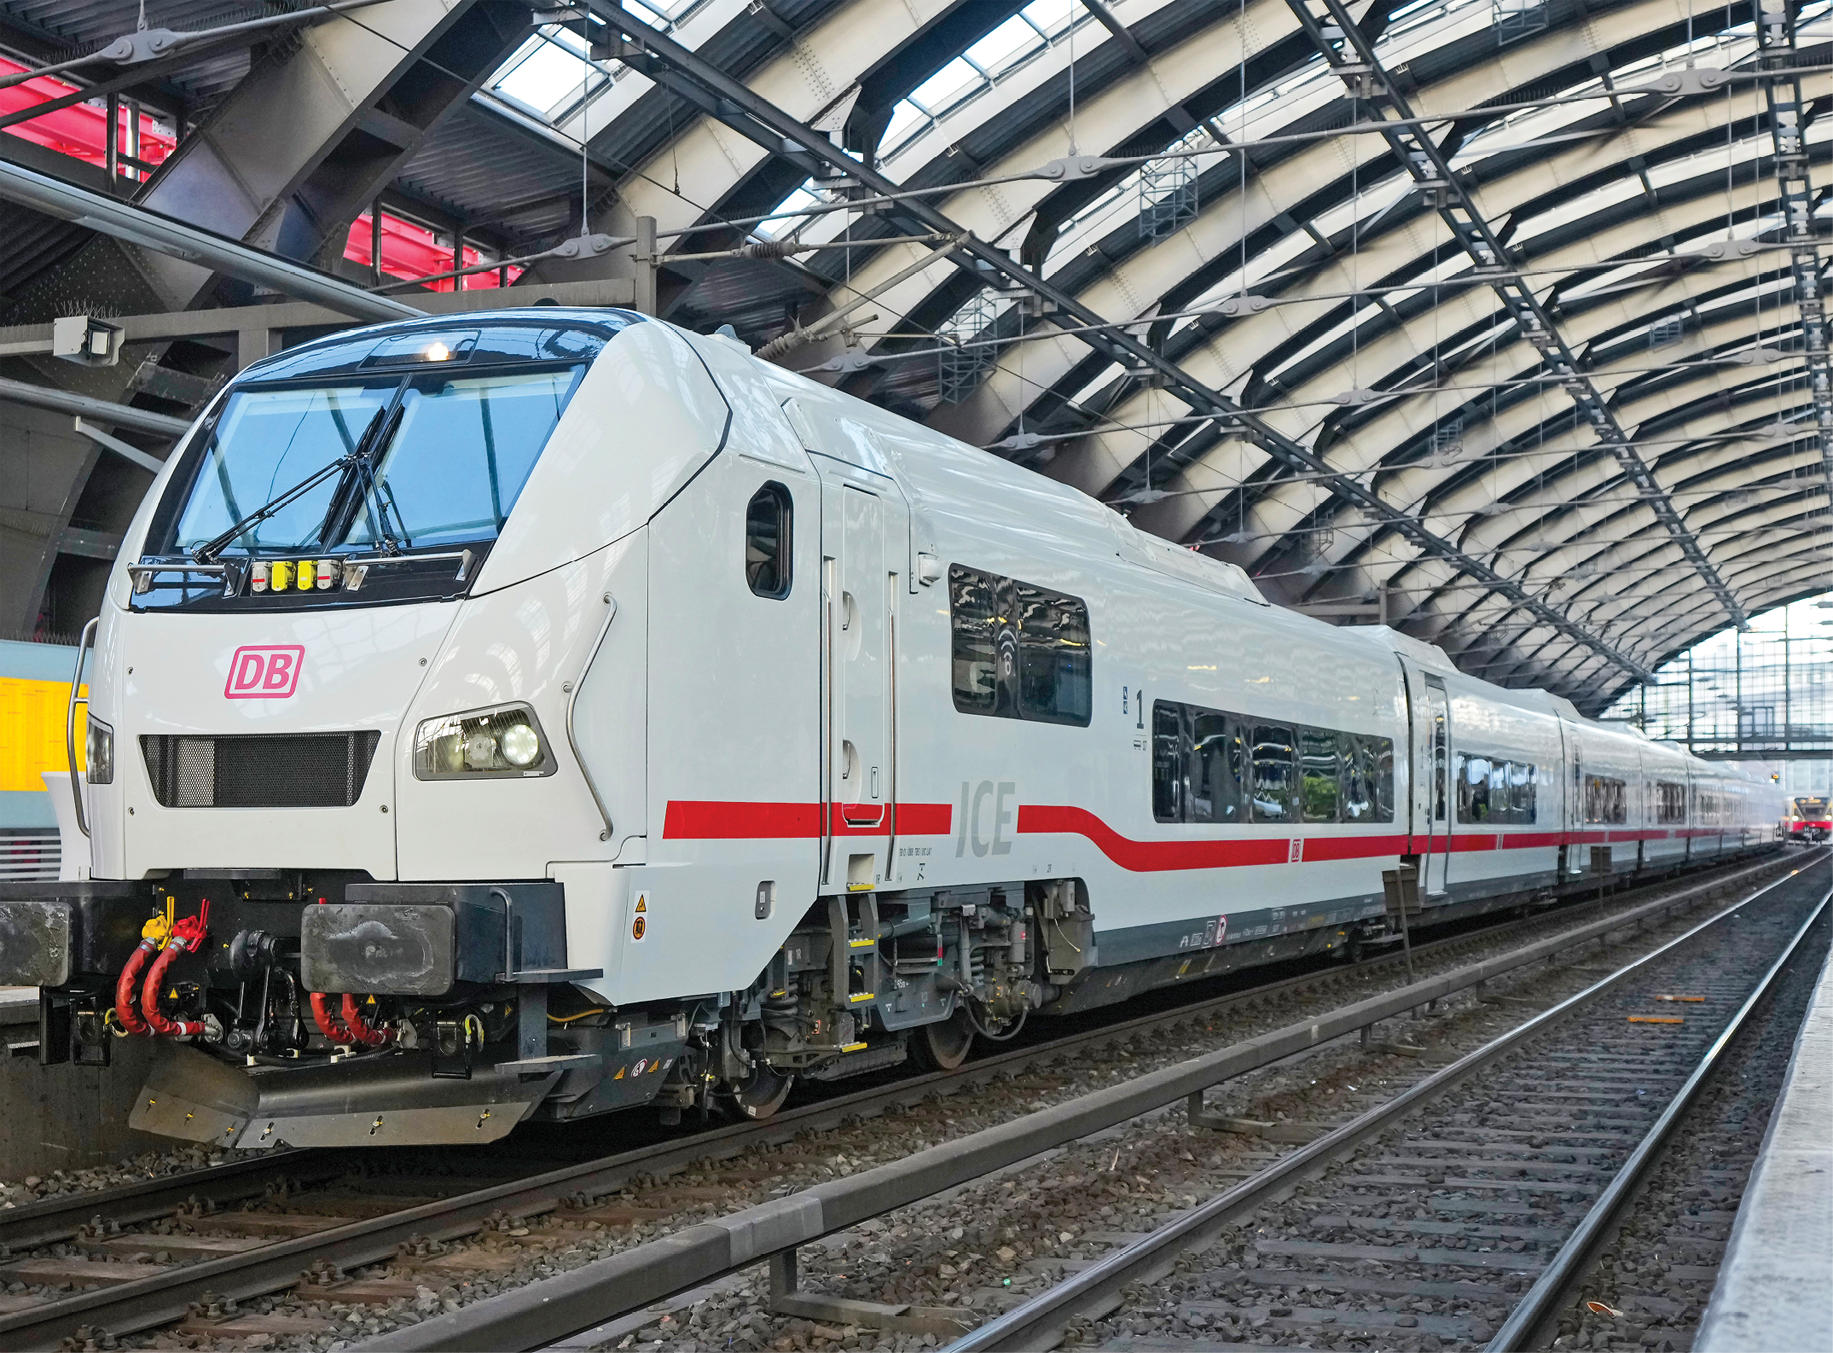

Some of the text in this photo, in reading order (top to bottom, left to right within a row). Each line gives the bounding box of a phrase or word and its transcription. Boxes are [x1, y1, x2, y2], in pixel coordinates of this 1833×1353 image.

[233, 653, 294, 691] DB
[1136, 689, 1145, 730] 1
[955, 779, 1016, 858] ICE
